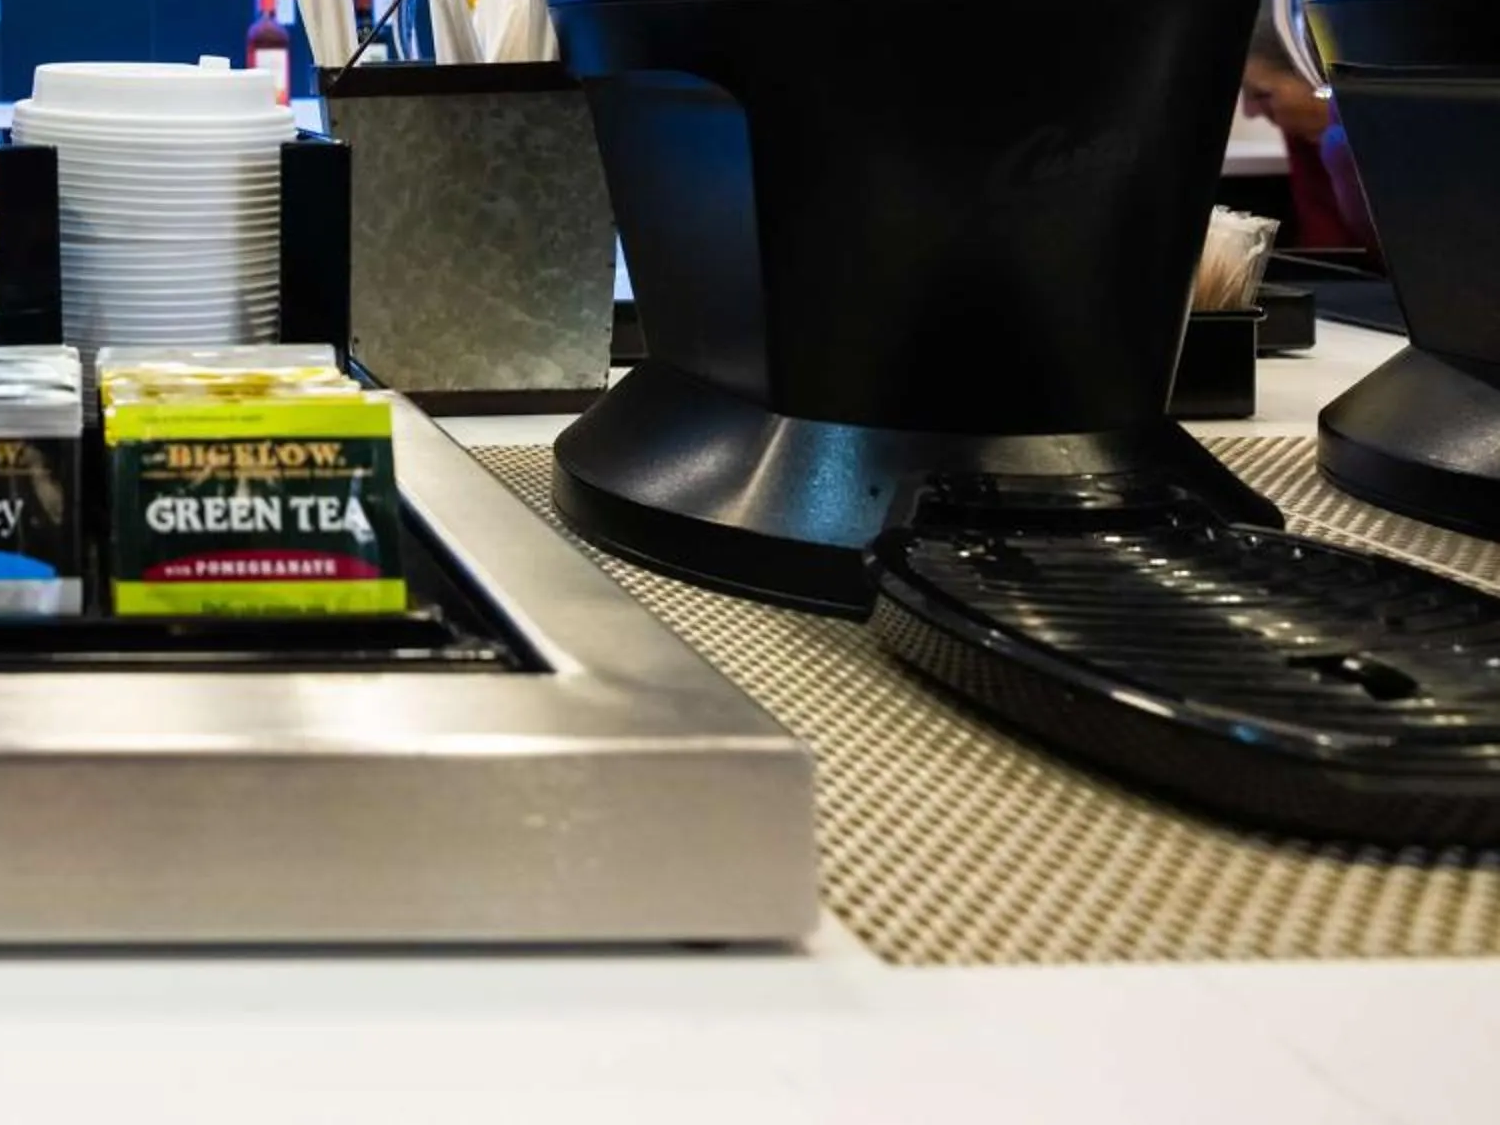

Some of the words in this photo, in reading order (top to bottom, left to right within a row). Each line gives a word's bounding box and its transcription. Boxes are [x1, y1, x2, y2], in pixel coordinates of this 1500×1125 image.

[146, 496, 282, 533] GREEN
[290, 496, 373, 533] TEA
[195, 559, 338, 576] POMEGRANATE
